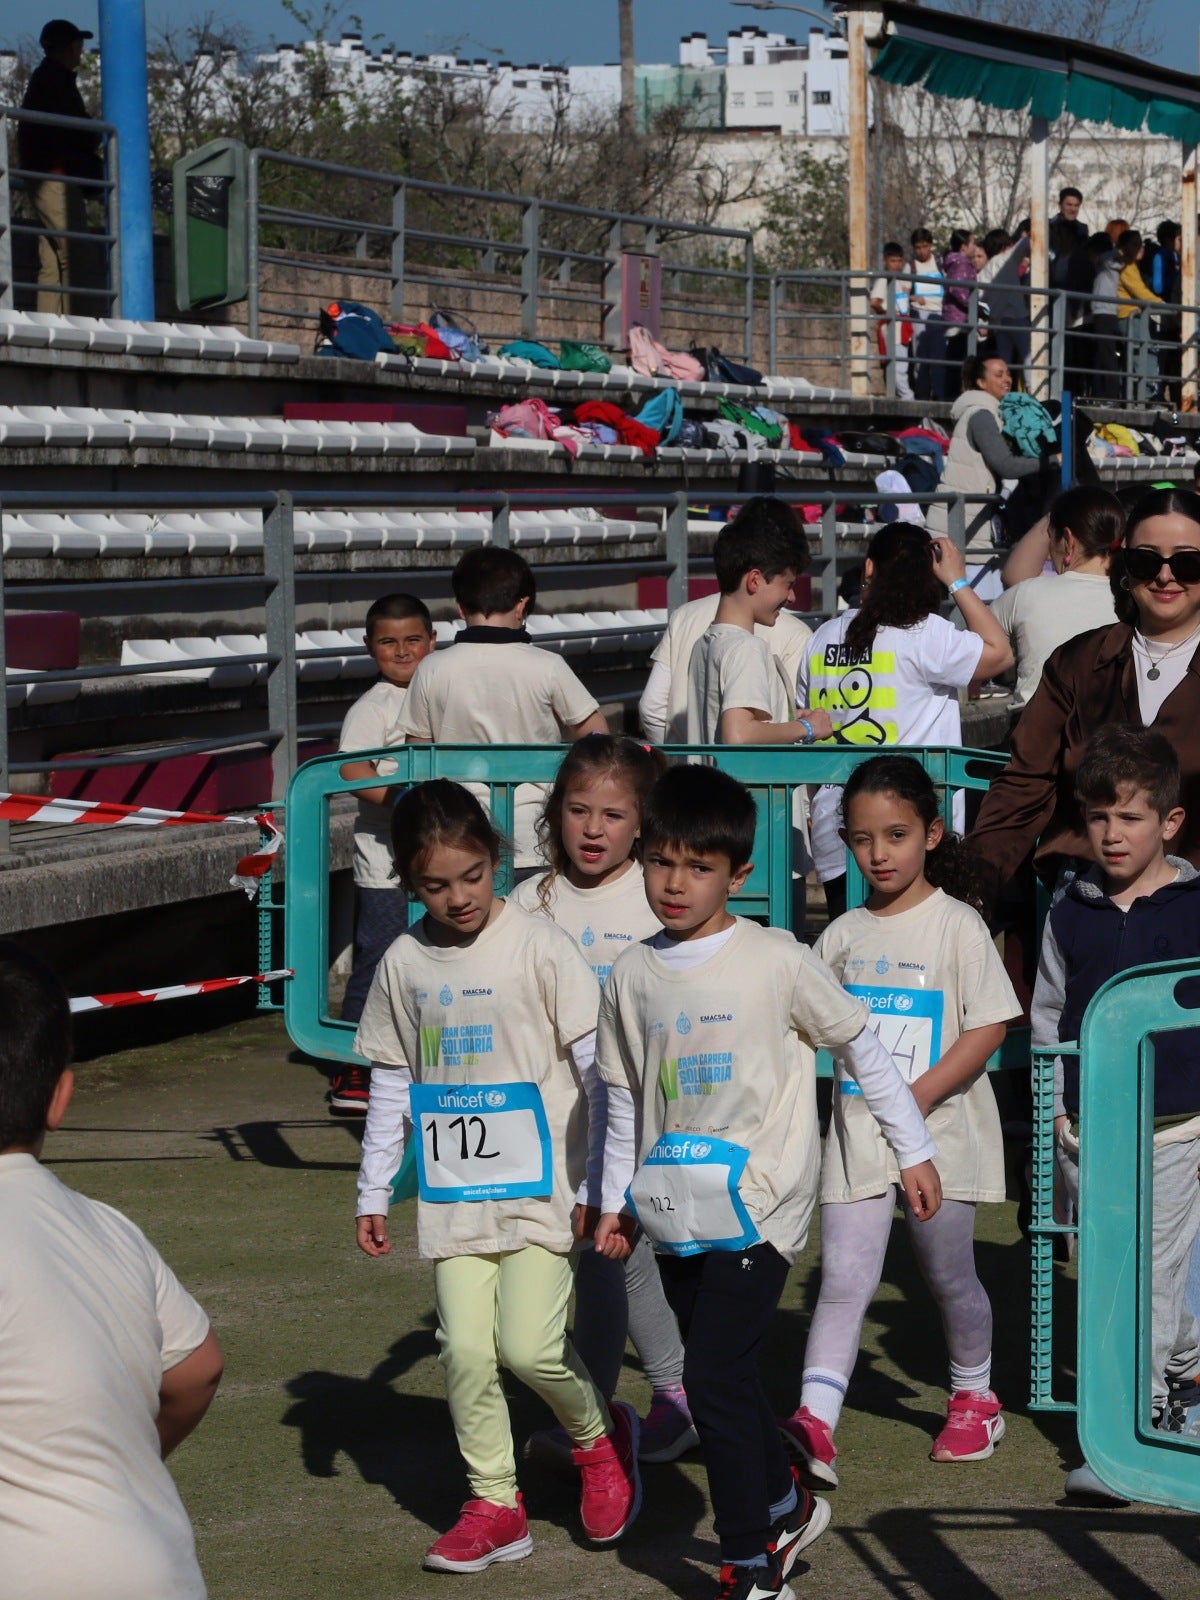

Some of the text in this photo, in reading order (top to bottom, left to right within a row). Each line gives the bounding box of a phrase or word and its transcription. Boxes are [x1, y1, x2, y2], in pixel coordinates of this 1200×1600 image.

[898, 961, 920, 970] EMACSA
[462, 988, 487, 996] EMACSA
[854, 992, 894, 1009] nicef
[700, 1014, 727, 1022] EMACSA
[460, 1024, 493, 1037] CARRERA
[442, 1036, 493, 1055] SOLIDARIA
[699, 1051, 733, 1066] CARRERA
[678, 1065, 732, 1085] SOLIDARIA
[437, 1091, 484, 1108] unicef
[650, 1196, 676, 1214] 122
